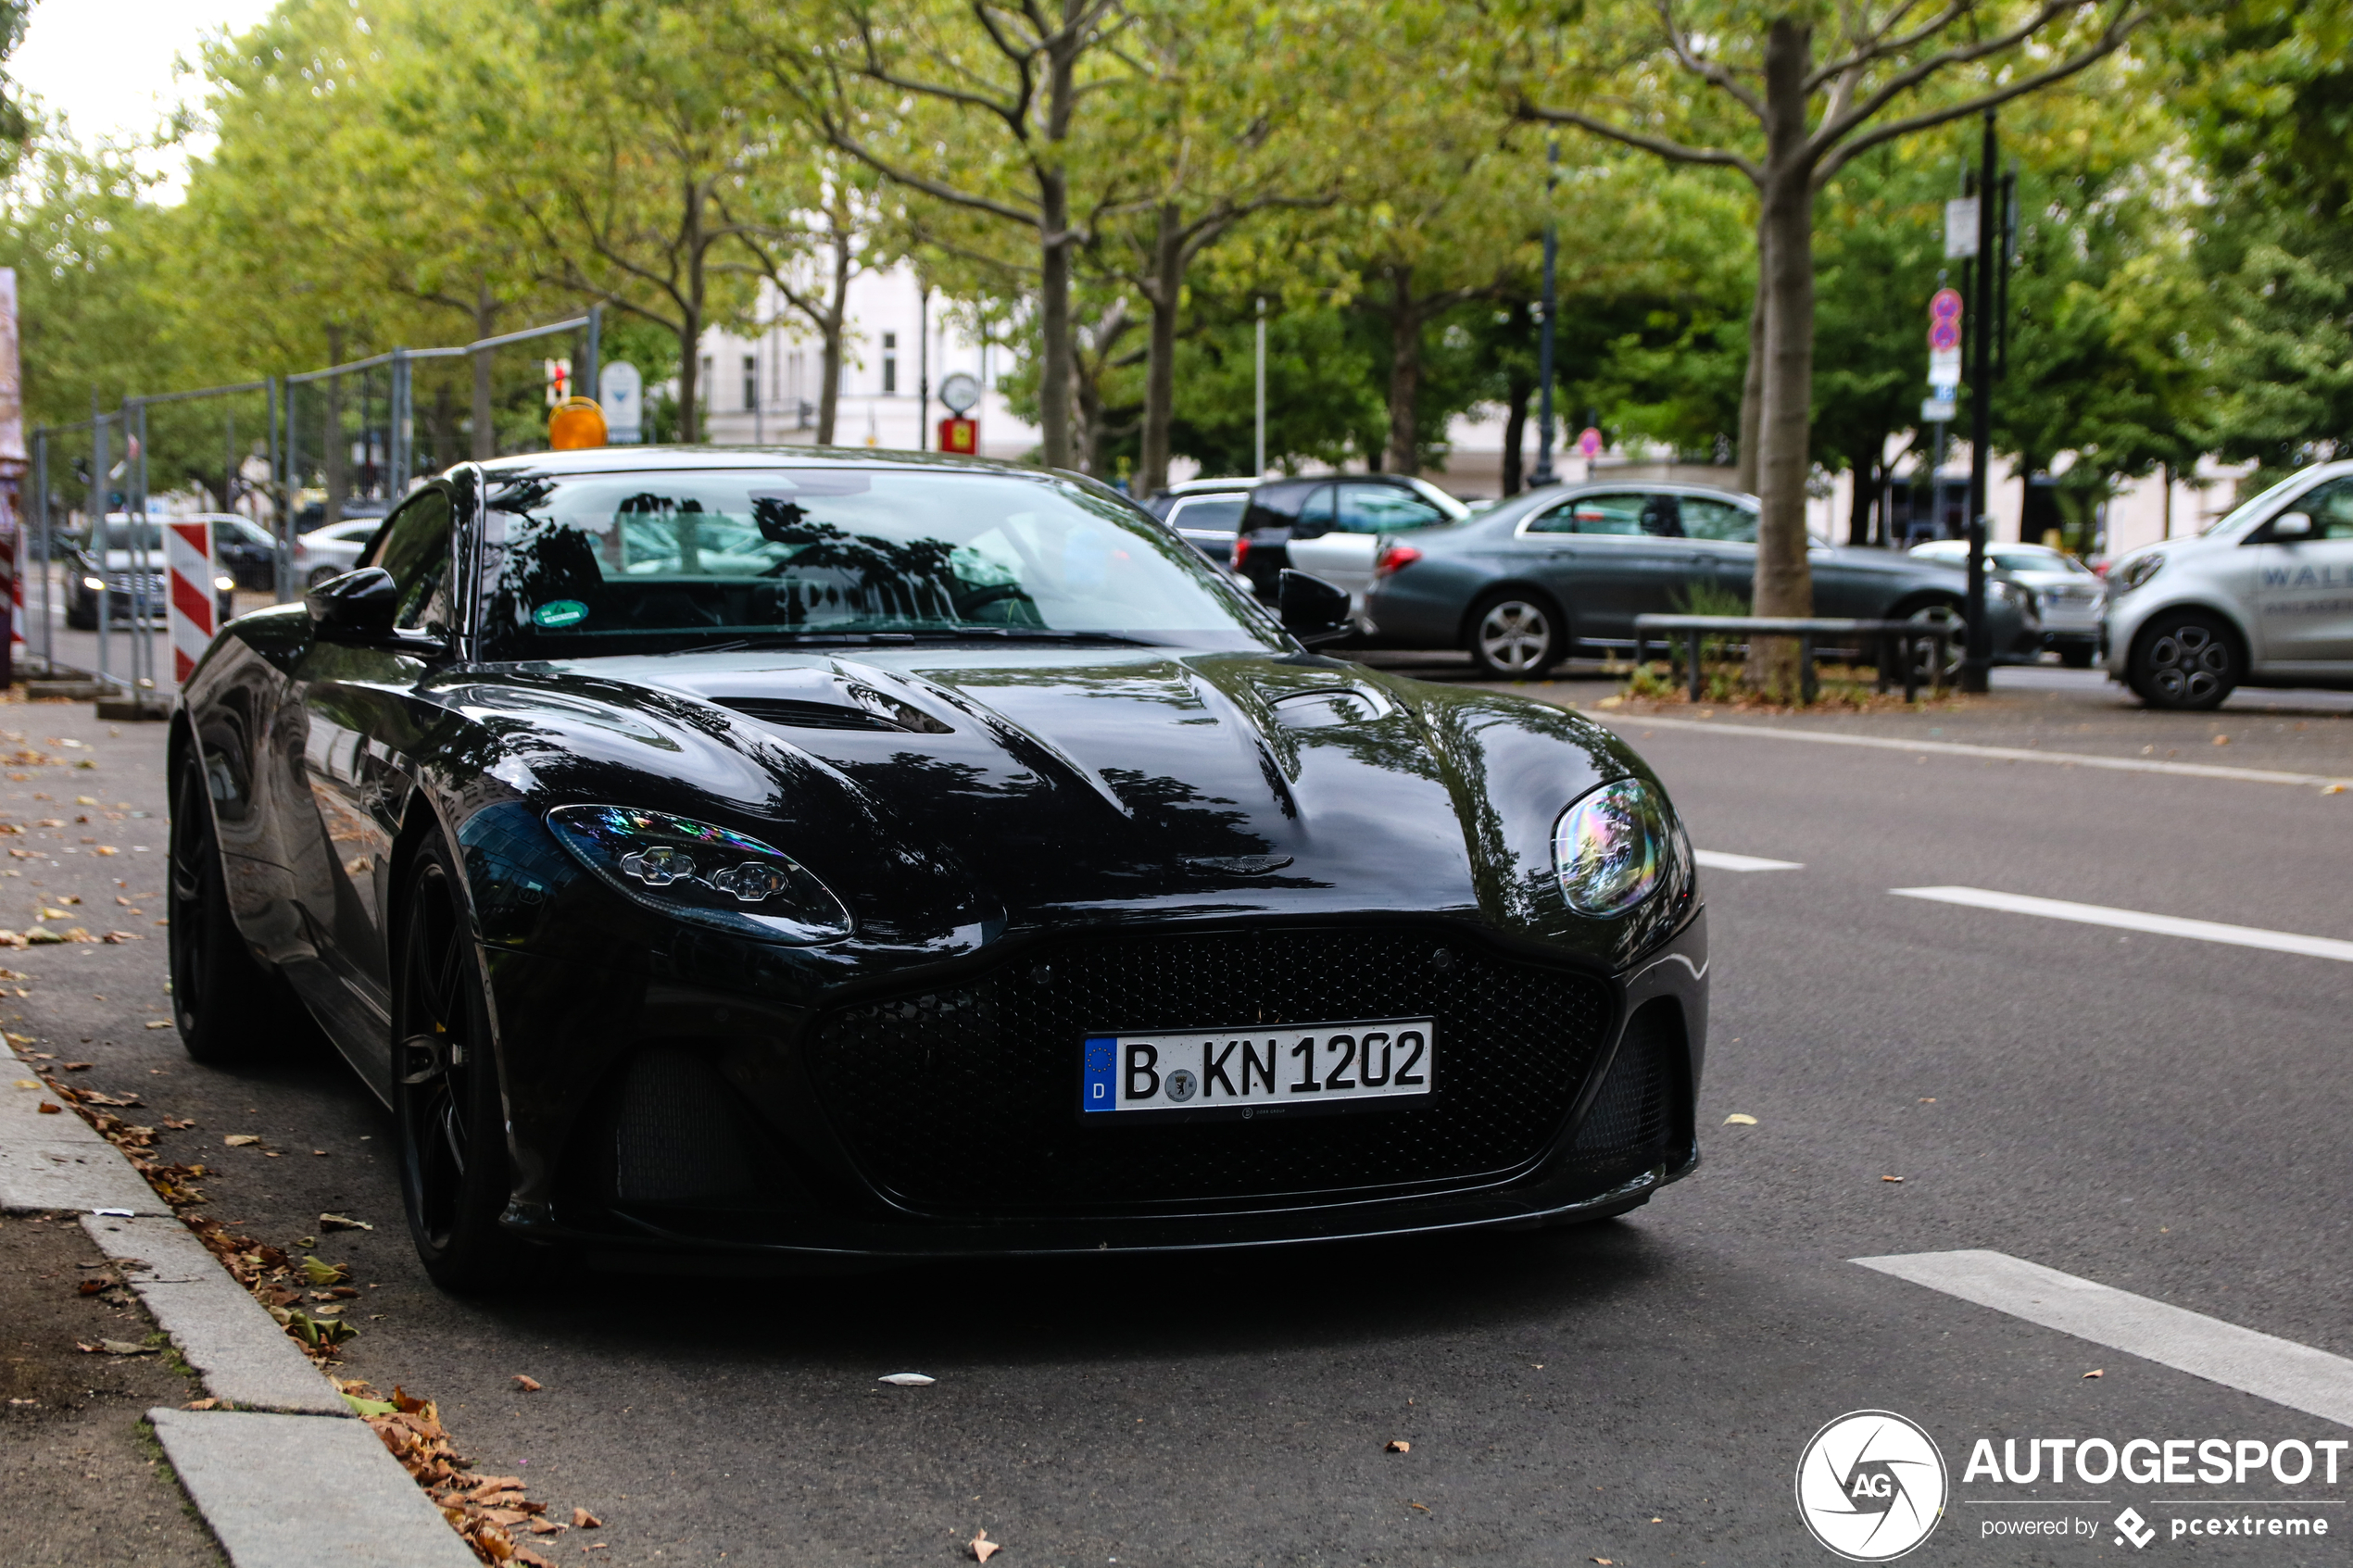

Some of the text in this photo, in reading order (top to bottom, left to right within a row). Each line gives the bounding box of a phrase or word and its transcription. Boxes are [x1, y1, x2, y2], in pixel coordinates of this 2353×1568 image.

[1125, 1030, 1425, 1100] B KN 1202
[1093, 1083, 1105, 1099] D
